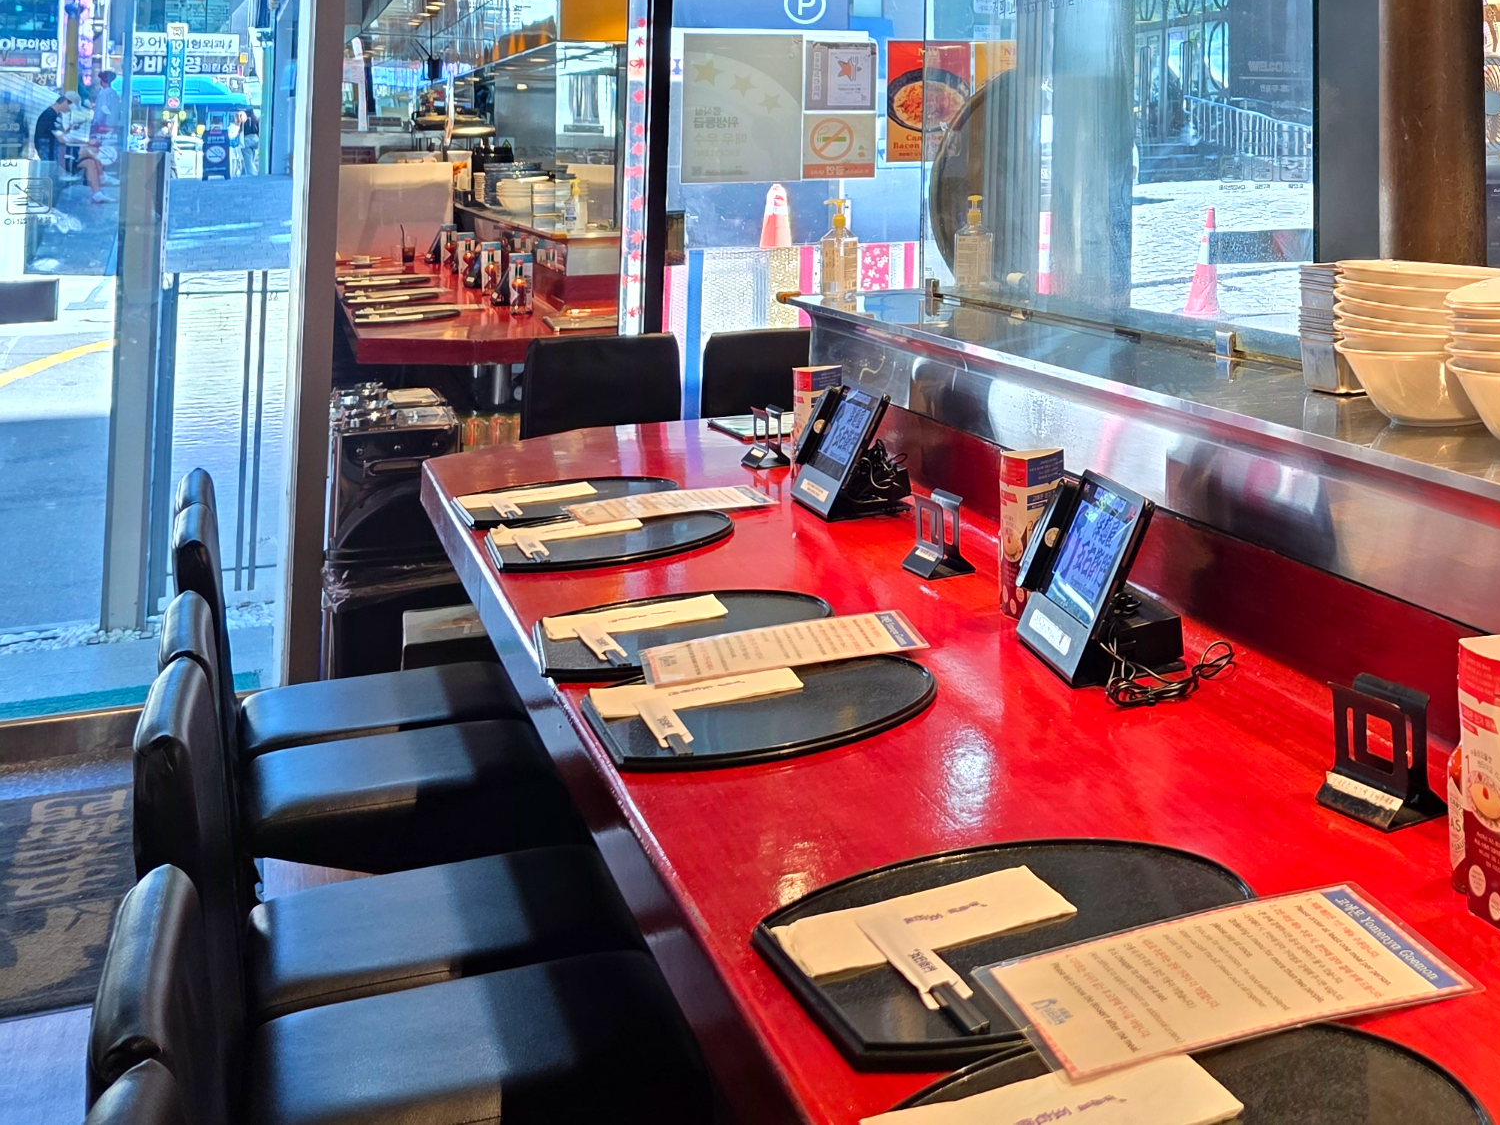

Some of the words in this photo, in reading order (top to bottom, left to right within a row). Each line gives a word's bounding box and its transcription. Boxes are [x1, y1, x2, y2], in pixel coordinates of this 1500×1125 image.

[172, 40, 184, 50] 10
[1208, 921, 1228, 934] please
[1221, 933, 1236, 942] pay
[1236, 945, 1252, 958] once.
[1227, 917, 1250, 935] Ordering
[1248, 937, 1266, 950] menu
[1261, 948, 1274, 956] for
[1269, 956, 1287, 969] more
[1282, 967, 1299, 979] than
[1294, 977, 1308, 987] two
[1293, 904, 1311, 917] Please
[1307, 916, 1324, 928] order
[1325, 931, 1344, 943] least
[1337, 942, 1352, 952] one
[1347, 951, 1367, 962] meal
[1358, 961, 1374, 970] per
[1367, 969, 1391, 986] person.
[1331, 896, 1365, 917] 고에몬
[1357, 916, 1403, 950] Yomenya
[1397, 948, 1439, 980] Goemon
[1050, 961, 1067, 975] Please
[1061, 973, 1075, 981] let
[1072, 984, 1086, 996] know
[1081, 994, 1093, 1003] the
[1087, 1001, 1111, 1019] dessert
[1103, 1018, 1119, 1031] after
[1114, 1029, 1128, 1040] the
[1122, 1039, 1142, 1053] meal.
[1114, 954, 1134, 970] cheaper
[1133, 974, 1149, 985] order
[1152, 992, 1168, 1003] set.
